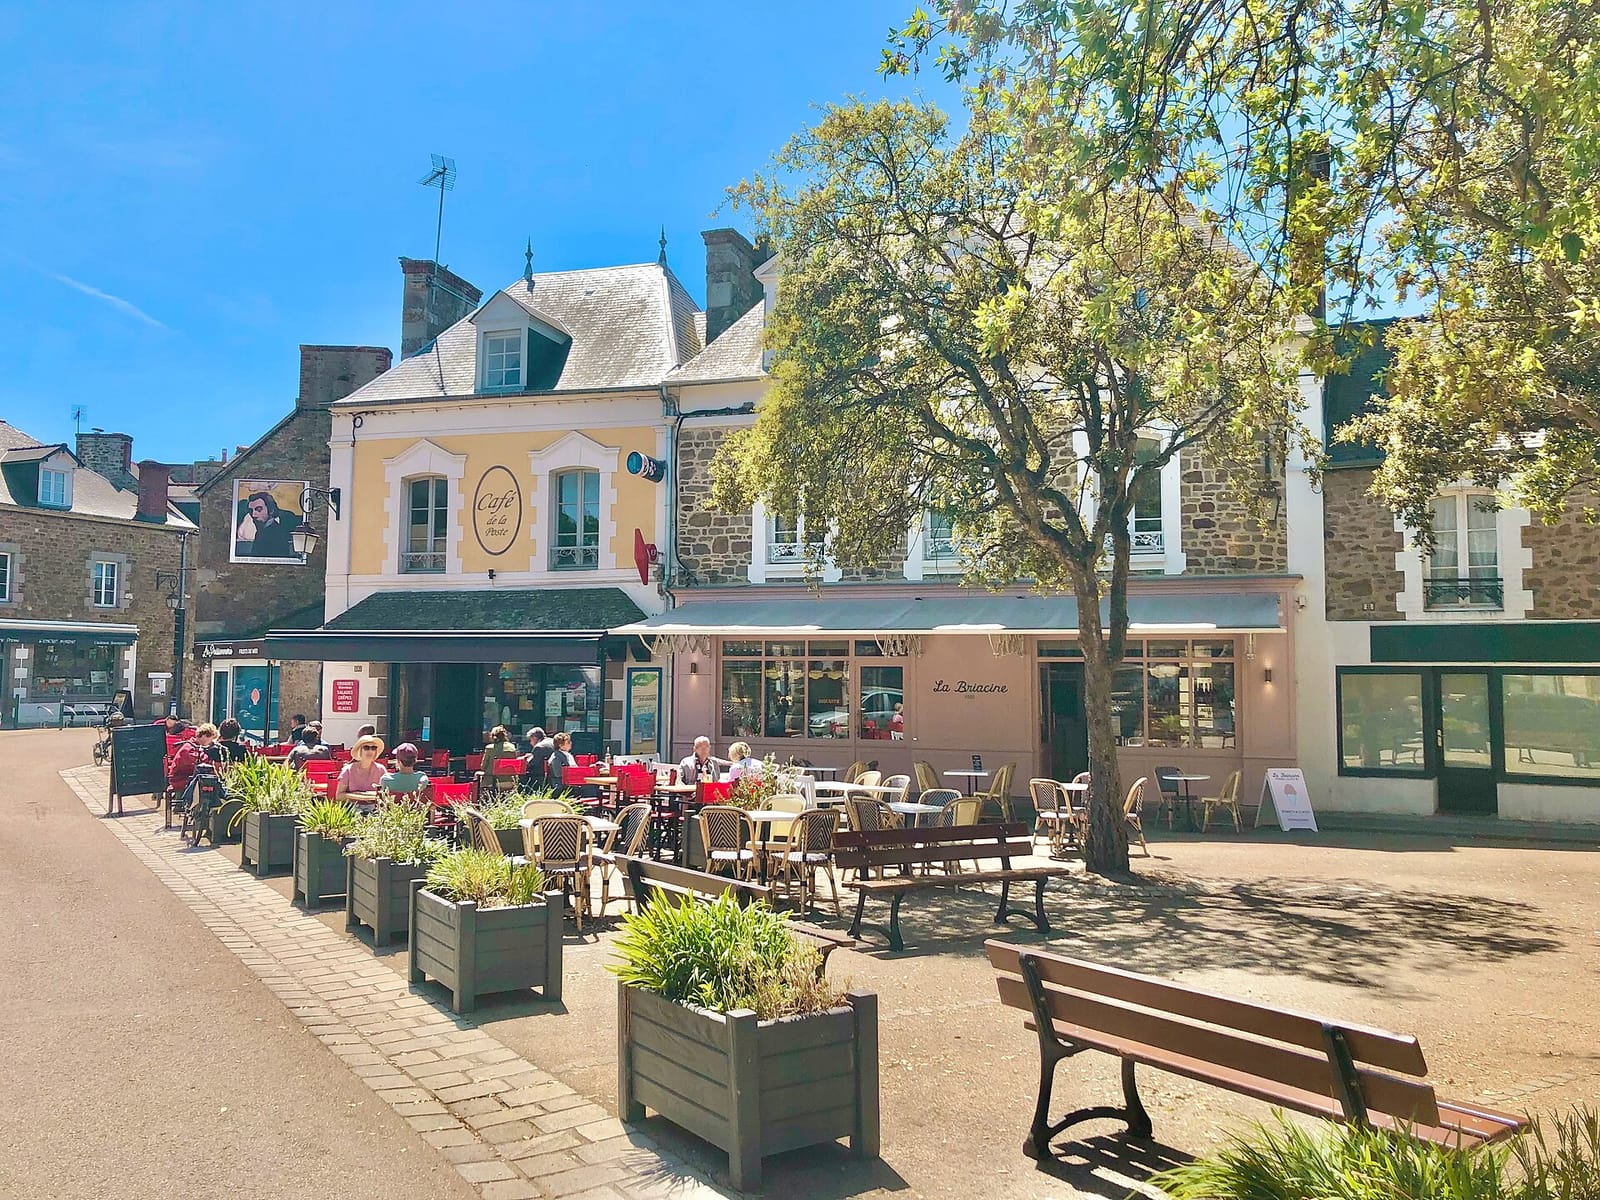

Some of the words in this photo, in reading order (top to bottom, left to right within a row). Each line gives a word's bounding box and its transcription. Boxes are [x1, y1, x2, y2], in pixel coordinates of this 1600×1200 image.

[477, 490, 517, 514] Café
[486, 515, 497, 525] de
[498, 515, 507, 525] la
[485, 527, 508, 536] Poste
[933, 680, 951, 692] La
[954, 680, 1008, 693] Briacine
